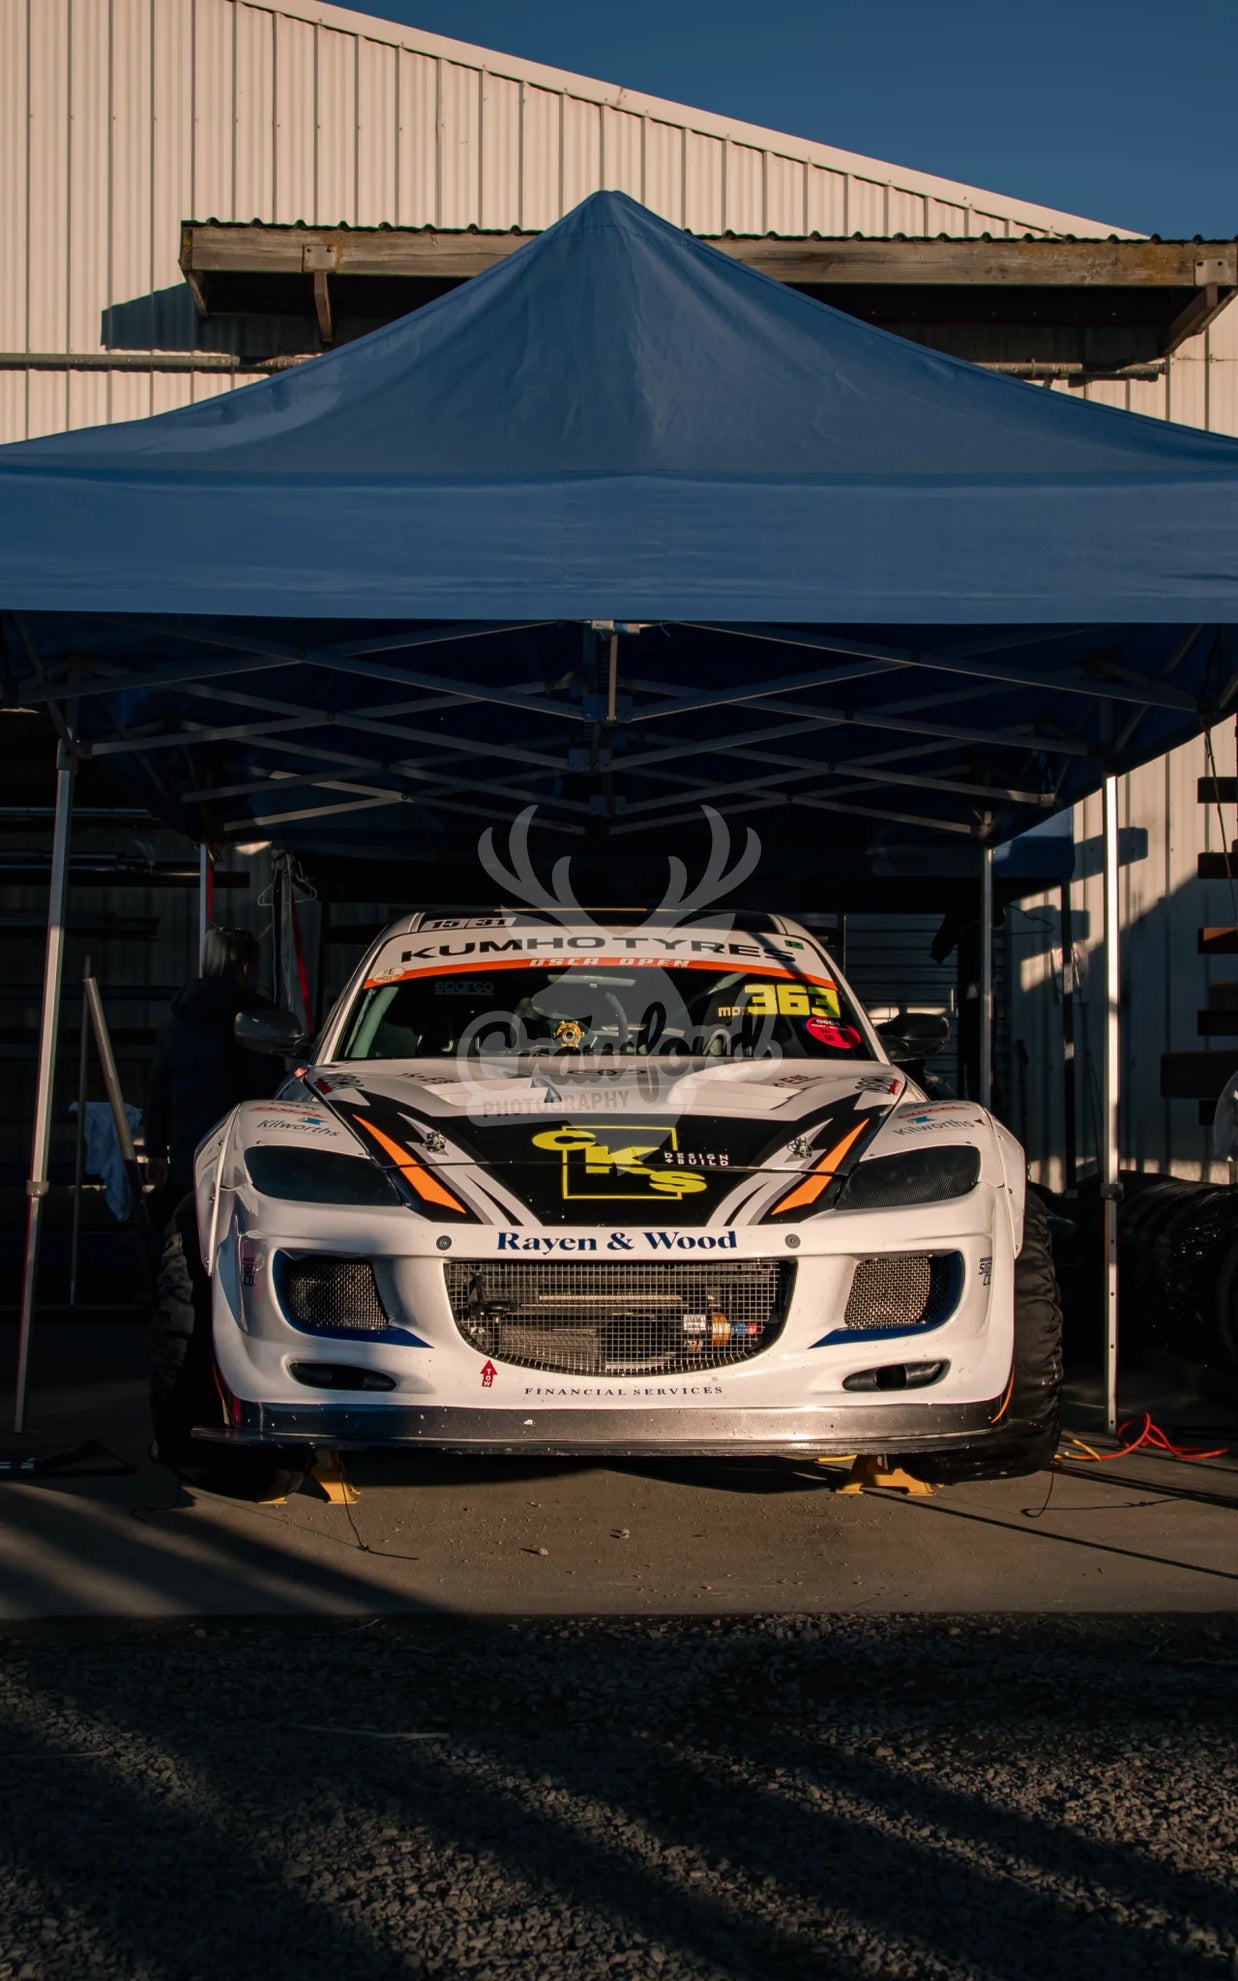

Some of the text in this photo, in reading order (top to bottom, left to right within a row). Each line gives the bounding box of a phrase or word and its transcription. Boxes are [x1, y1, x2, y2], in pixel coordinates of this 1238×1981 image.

[430, 919, 461, 928] 15
[475, 918, 507, 927] 31
[401, 936, 605, 963] KUMHO
[529, 957, 690, 968] OSCA OPEN
[434, 980, 495, 996] sparco
[744, 984, 841, 1018] 363
[256, 1119, 342, 1137] Kilworths
[892, 1119, 975, 1136] Kilworths
[532, 1130, 707, 1193] CKS
[663, 1151, 729, 1161] DESIGN
[497, 1230, 738, 1255] Rayen & Wood
[483, 1368, 492, 1386] TOW
[525, 1385, 724, 1396] FINANCIAL SERVICES
